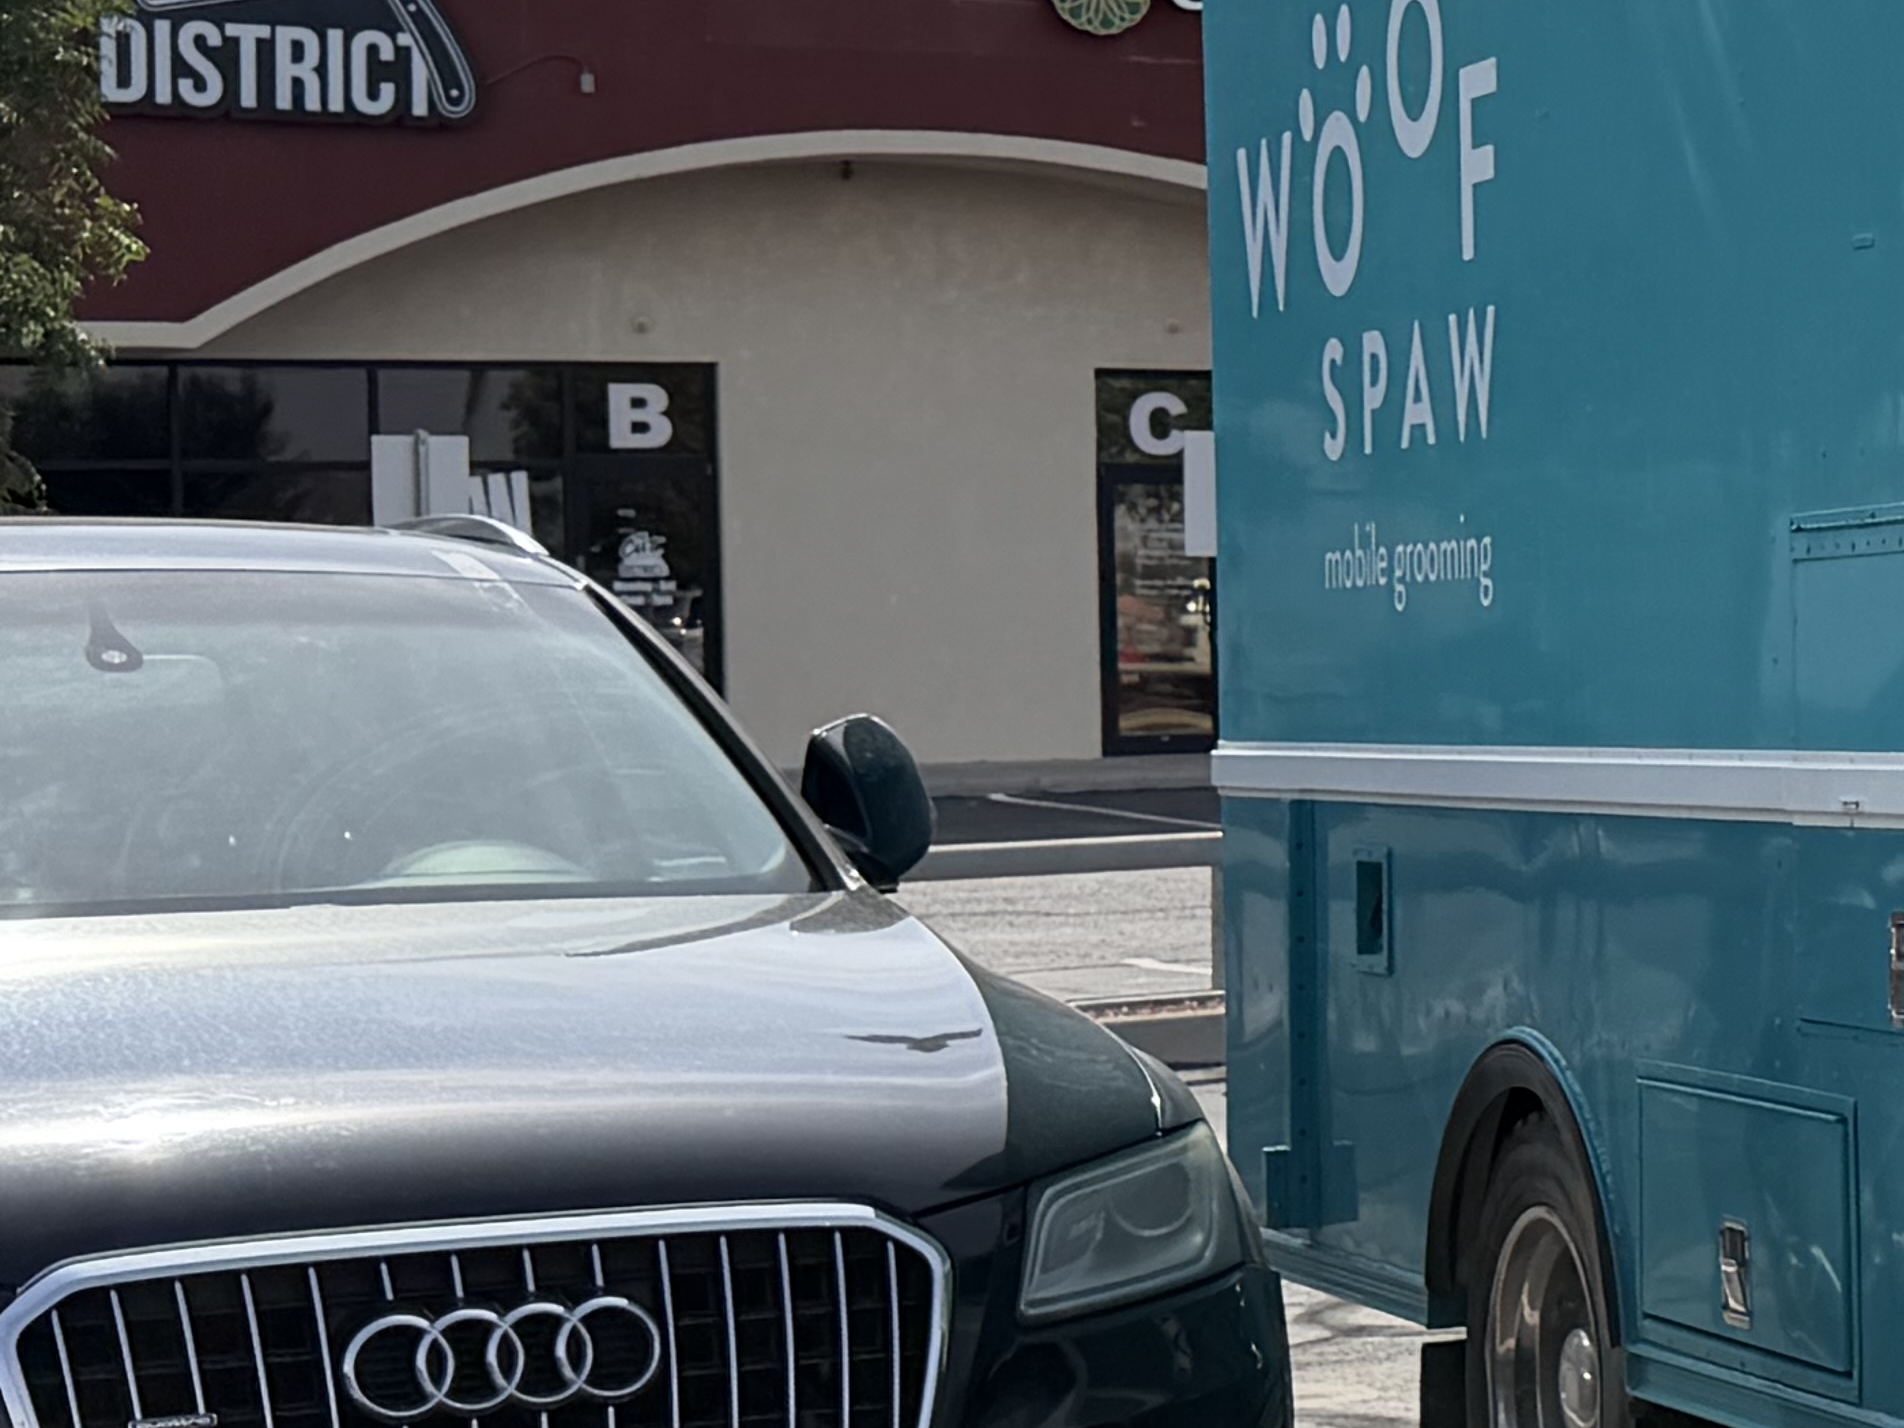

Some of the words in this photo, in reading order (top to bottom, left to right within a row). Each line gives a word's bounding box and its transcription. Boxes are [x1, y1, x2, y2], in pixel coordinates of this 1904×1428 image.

[100, 15, 429, 117] DISTRICT
[608, 382, 673, 449] B
[1129, 391, 1188, 456] C
[1322, 304, 1496, 462] SPAW
[1323, 522, 1388, 591] mobile
[1393, 515, 1493, 611] grooming
